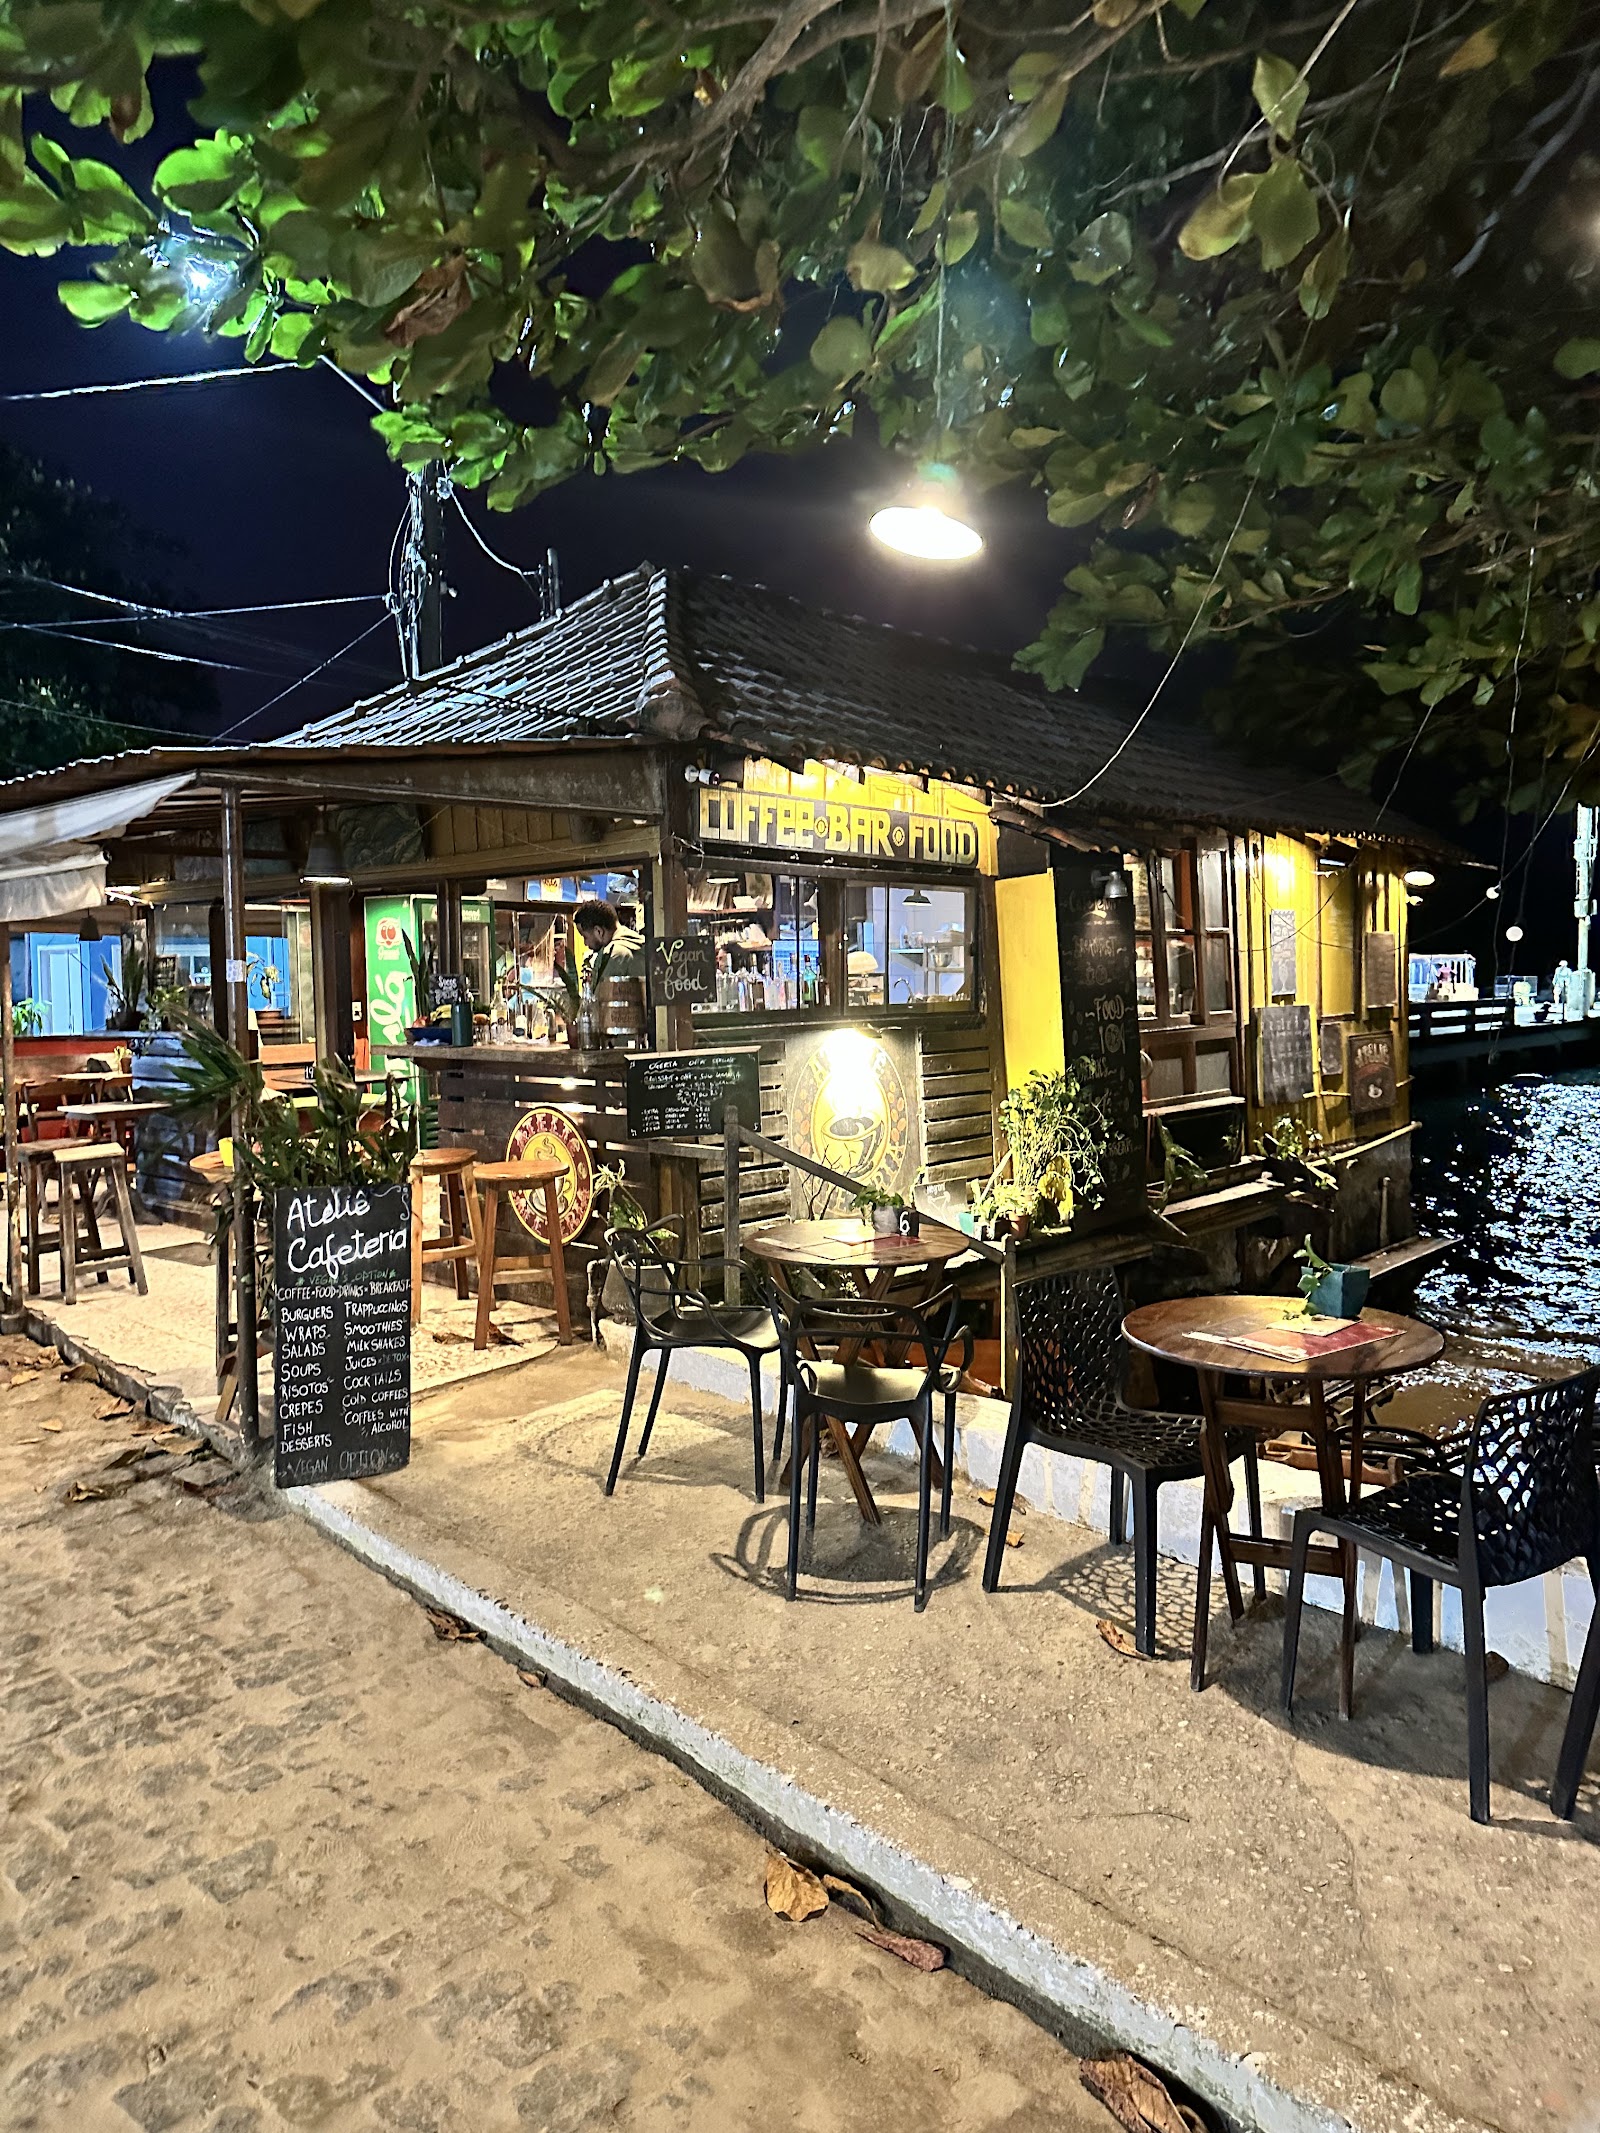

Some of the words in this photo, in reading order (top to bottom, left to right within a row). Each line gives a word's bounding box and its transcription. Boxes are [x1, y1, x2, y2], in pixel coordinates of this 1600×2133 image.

[700, 789, 814, 849] COFFEE
[825, 803, 895, 858] BAR
[909, 815, 978, 866] FOOD
[656, 939, 708, 979] Vegan
[659, 966, 708, 1000] food
[305, 1065, 314, 1079] 19
[286, 1187, 371, 1232] Ateliê
[900, 1211, 910, 1236] 6
[287, 1228, 407, 1280] Cafeteria
[277, 1286, 311, 1301] COFFEE
[315, 1285, 336, 1299] FOOD
[369, 1279, 409, 1296] BREAKFAST
[280, 1305, 334, 1324] BURGUERS
[344, 1299, 409, 1318] FRAPPUCCINOS
[284, 1324, 327, 1342] WRAPS
[344, 1319, 403, 1336] SMOOTHIES
[281, 1342, 326, 1360] SALADS
[280, 1362, 322, 1383] SOUPS
[344, 1355, 377, 1371] JUICES
[280, 1381, 329, 1401] RISOTOS
[371, 1387, 409, 1403] COFFEES
[280, 1399, 324, 1420] CREPES
[344, 1408, 385, 1426] COFFEES
[283, 1420, 313, 1441] FISH
[281, 1433, 333, 1455] DESSERTS
[288, 1454, 329, 1478] VEGAN
